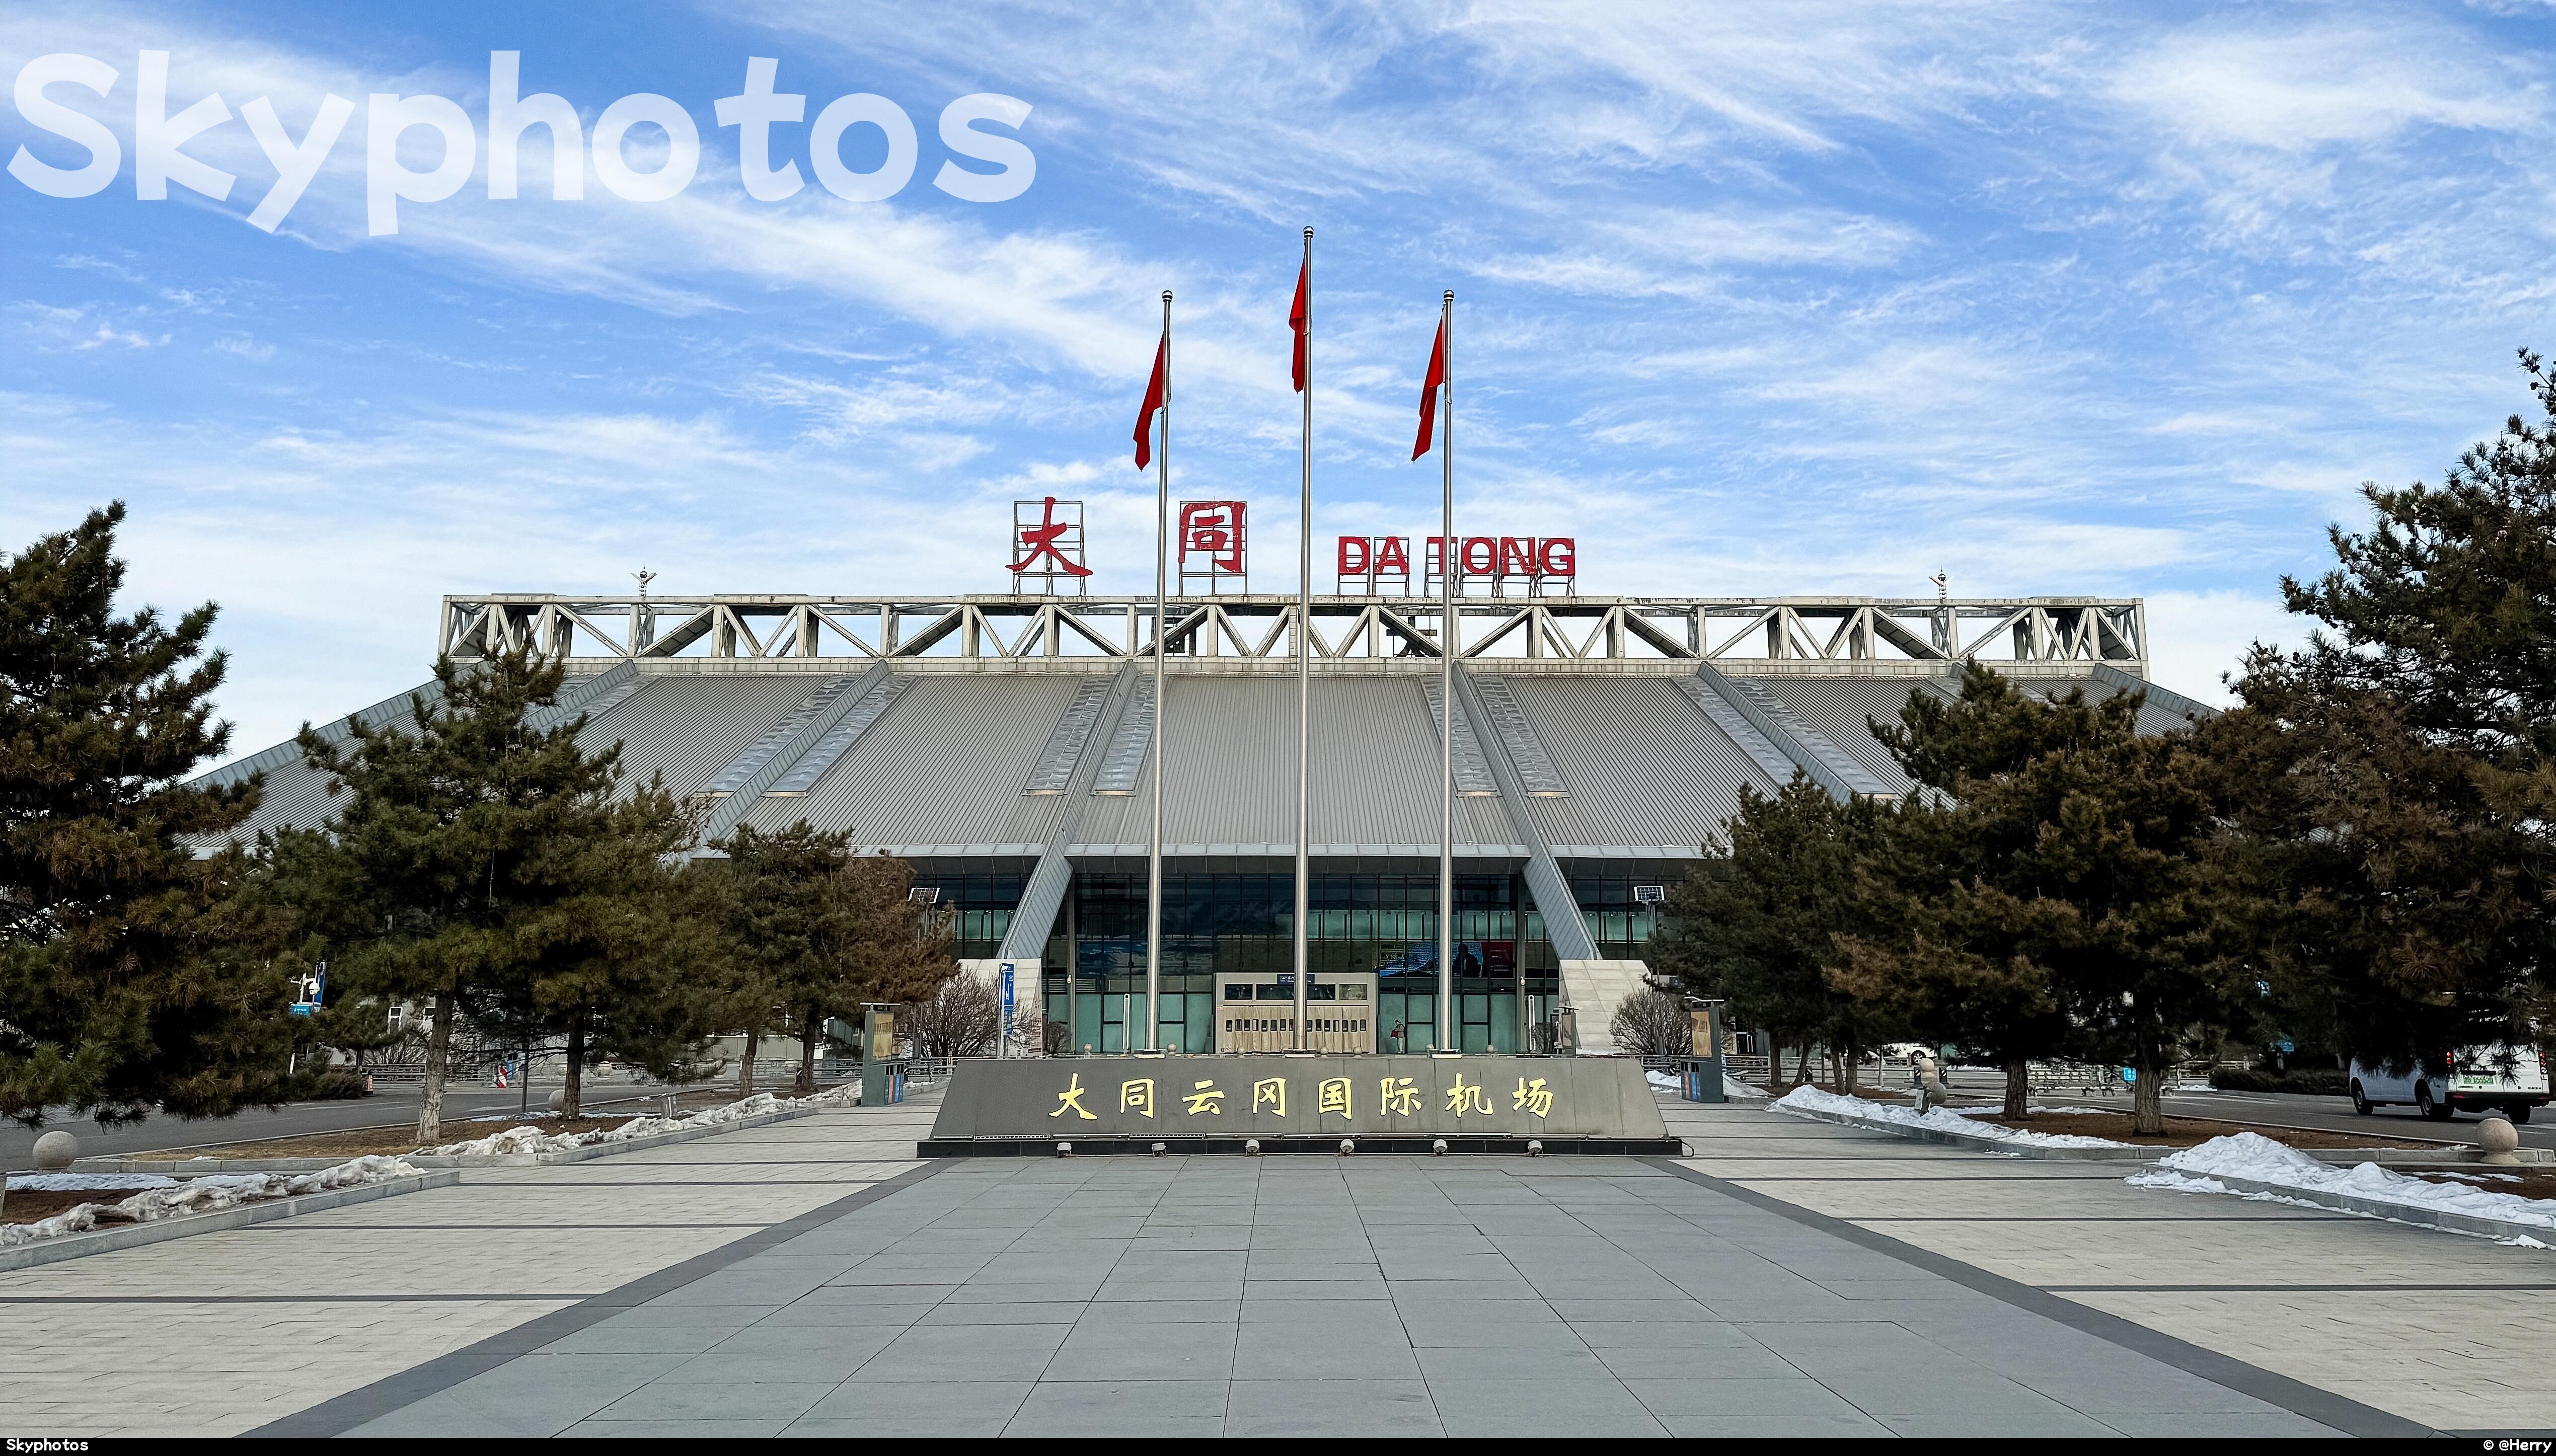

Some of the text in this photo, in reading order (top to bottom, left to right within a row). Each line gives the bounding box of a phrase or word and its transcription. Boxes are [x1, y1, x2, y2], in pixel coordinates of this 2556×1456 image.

[1006, 496, 1247, 576] 大同
[1338, 537, 1575, 575] DA TONG
[1048, 1072, 1554, 1120] 大同云冈国际机场
